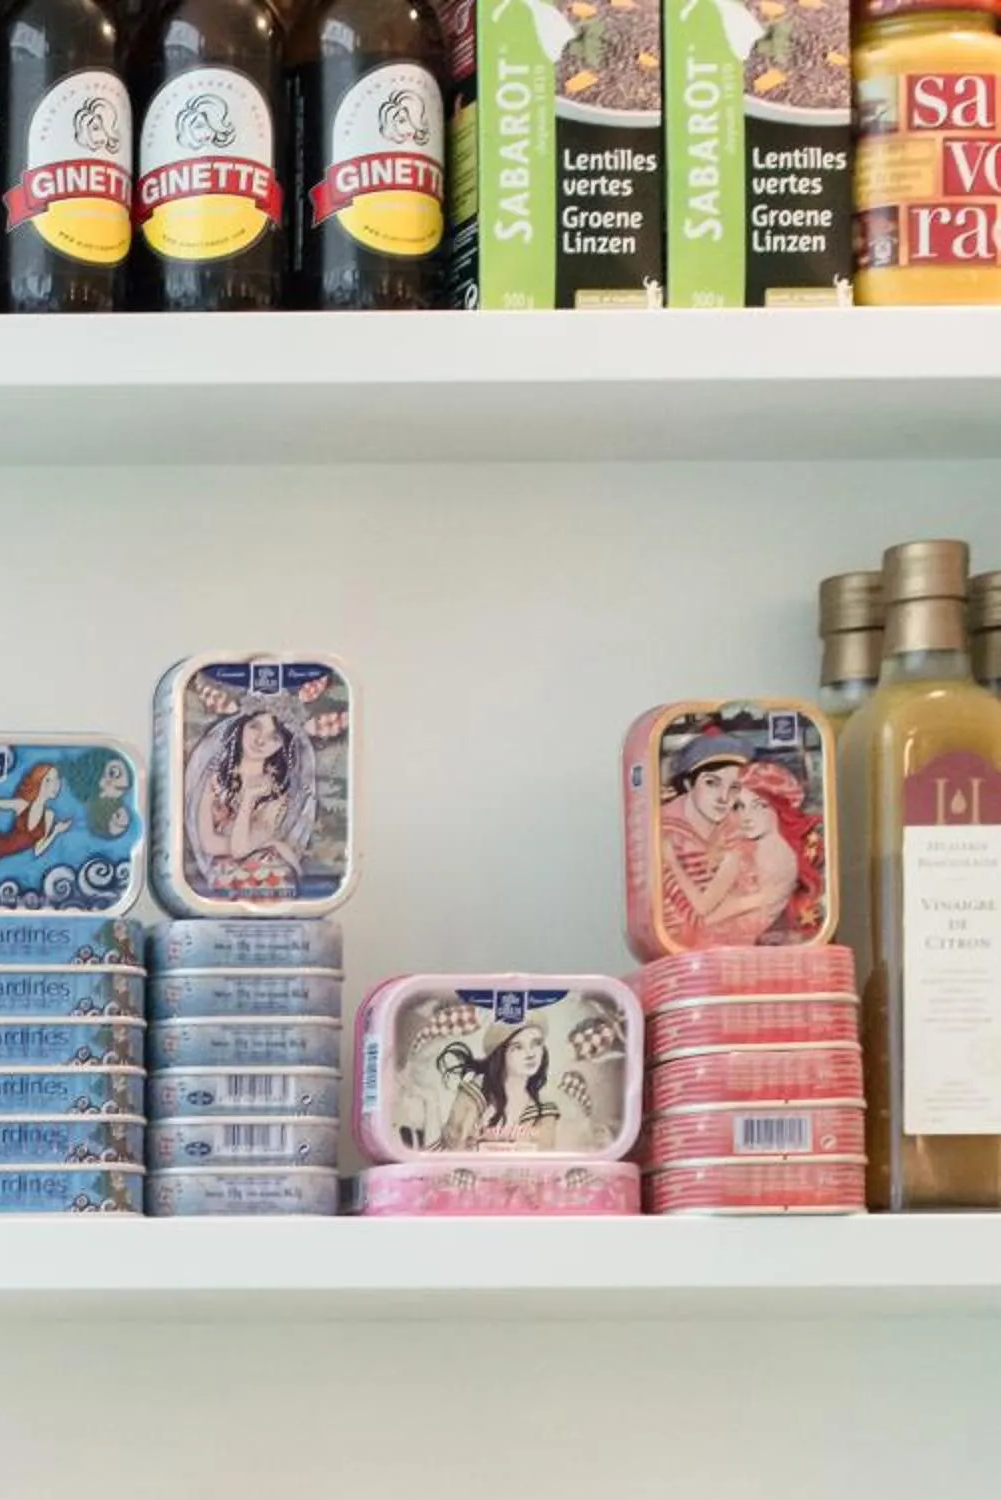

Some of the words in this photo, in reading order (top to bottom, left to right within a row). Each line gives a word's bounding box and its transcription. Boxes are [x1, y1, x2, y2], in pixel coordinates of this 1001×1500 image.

[913, 75, 995, 129] sa
[493, 59, 533, 243] SABAROT
[563, 148, 658, 172] Lentilles
[684, 59, 724, 242] SABAROT
[752, 146, 847, 171] Lentilles
[31, 164, 131, 201] GINETT
[142, 163, 270, 205] GINETTE
[563, 177, 634, 197] vertes
[752, 175, 823, 196] vertes
[562, 205, 644, 230] Groene
[751, 203, 833, 229] Groene
[563, 230, 637, 254] Linzen
[752, 229, 826, 253] Linzen
